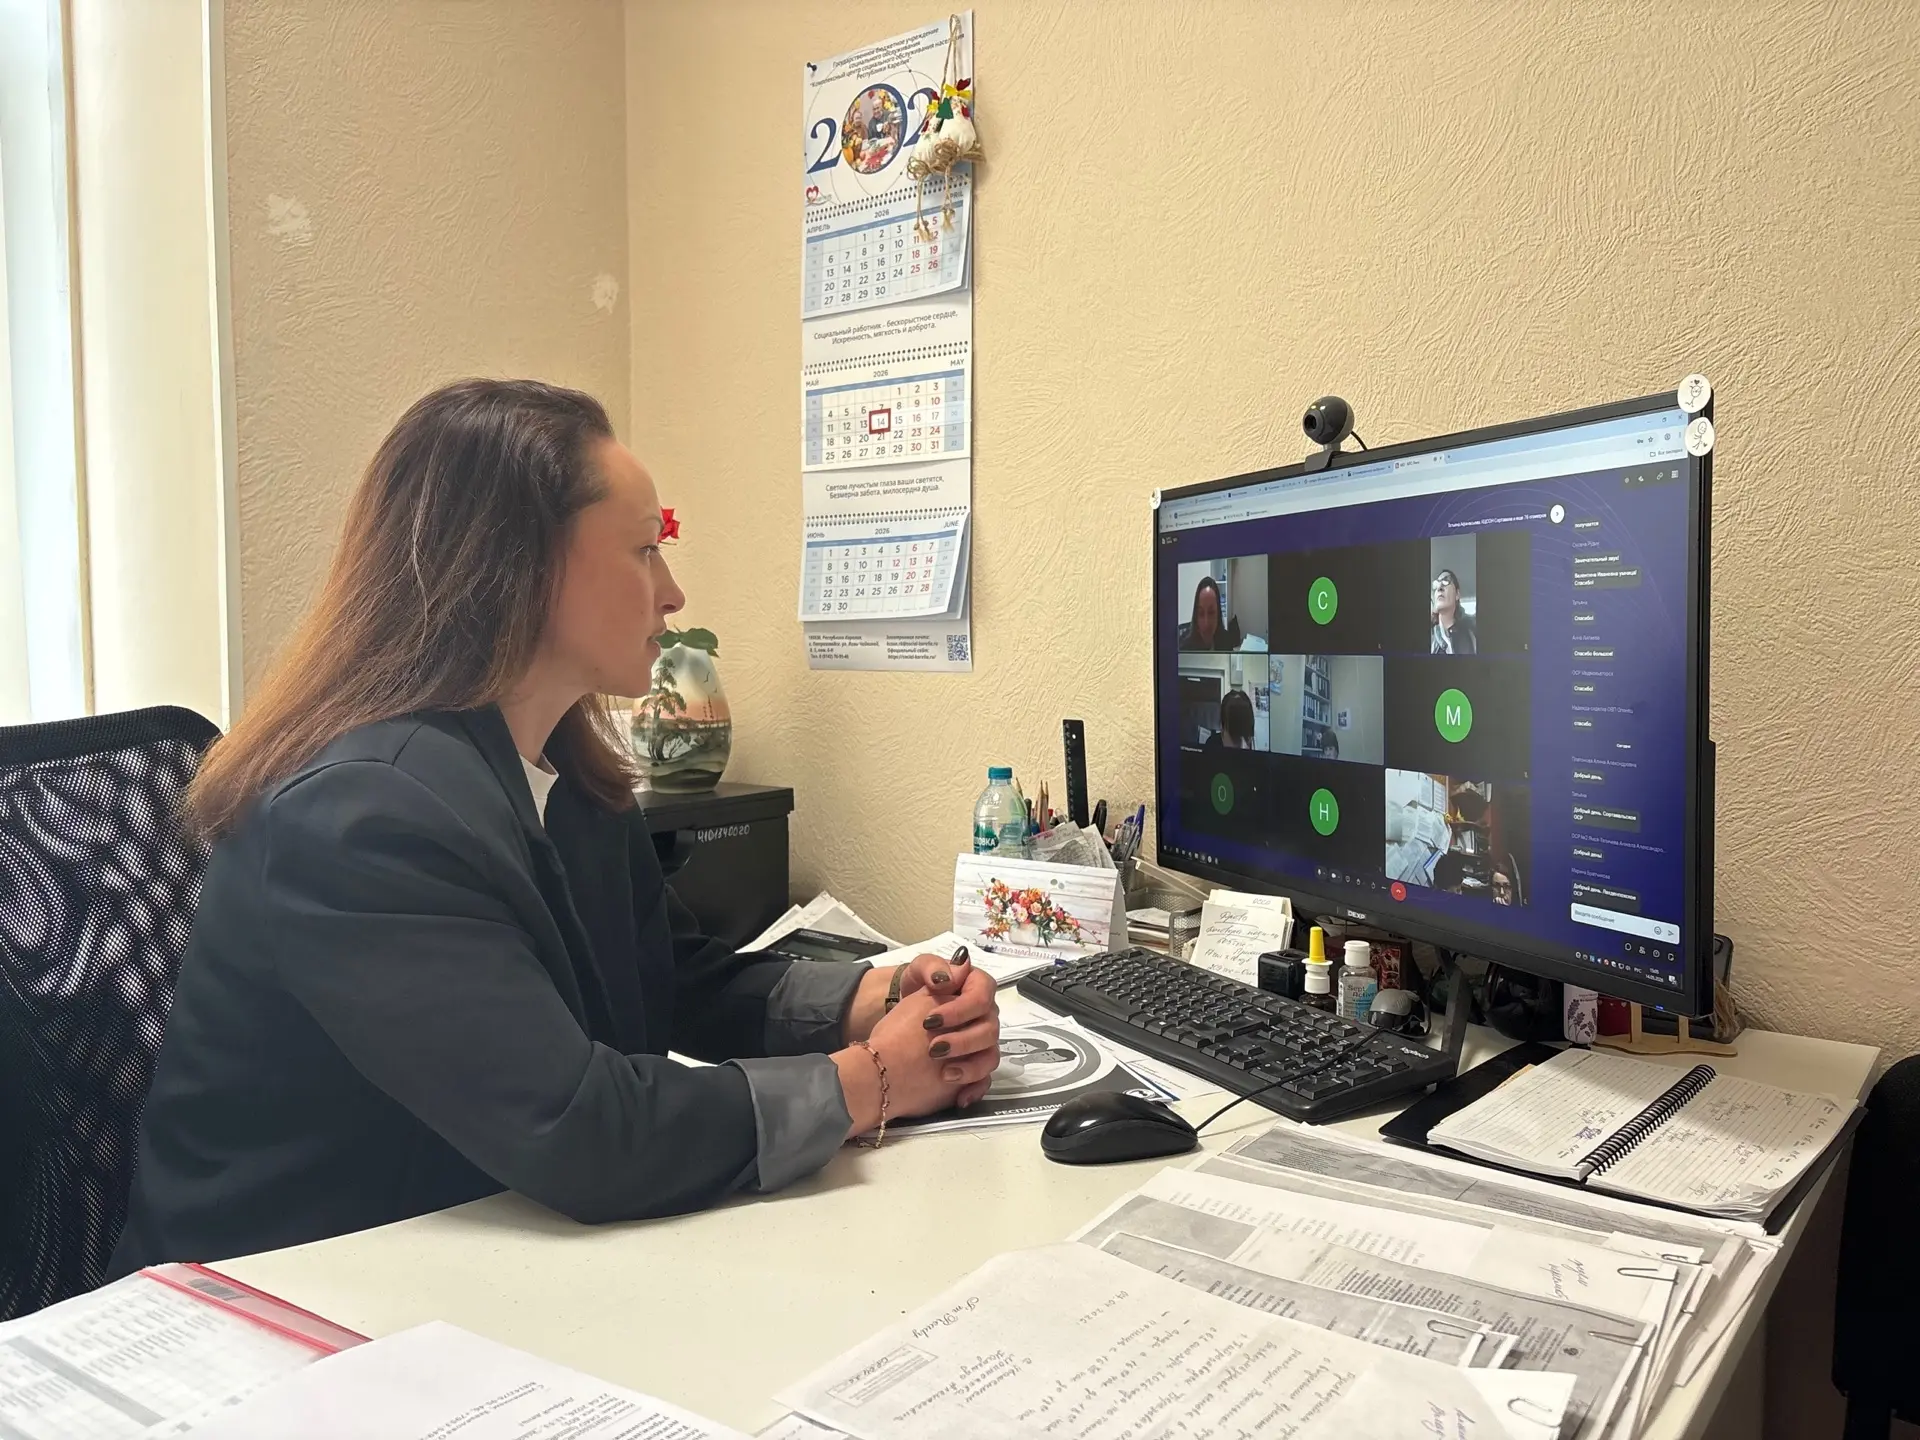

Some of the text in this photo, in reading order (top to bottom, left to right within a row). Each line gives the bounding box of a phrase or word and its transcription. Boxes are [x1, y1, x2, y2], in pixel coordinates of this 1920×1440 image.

[905, 27, 939, 46] учреждение
[846, 67, 862, 78] центр
[861, 57, 895, 72] социального
[895, 45, 934, 61] обслуживания
[848, 54, 881, 69] социального
[950, 191, 964, 199] PRIL
[874, 209, 890, 218] 2026
[806, 224, 831, 234] АПРЕЛЬ
[814, 309, 958, 340] Социальный работник бескорыстное сердце,
[832, 334, 872, 345] Искренность,
[873, 329, 901, 339] мягкость
[908, 322, 936, 334] доброта.
[950, 359, 965, 367] MAY
[873, 370, 889, 378] 2026
[931, 396, 941, 405] 10
[827, 411, 940, 432] 11 12 13 14 15 16 17
[826, 437, 834, 446] 18
[843, 435, 851, 444] 19
[859, 434, 869, 443] 20
[893, 430, 903, 439] 22
[911, 427, 922, 437] 23
[930, 426, 940, 435] 24
[825, 440, 939, 460] 25 26 27 28 29 30 31
[825, 475, 944, 492] Светом лучистым глаза ваши светятся,
[829, 484, 939, 500] Безмерна забота, милосердна душа.
[943, 519, 959, 528] JUNE
[807, 531, 825, 539] ИЮНЬ
[859, 561, 867, 569] 10
[877, 560, 883, 568] 11
[893, 559, 901, 567] 12
[909, 557, 917, 566] 13
[926, 556, 933, 564] 14
[825, 569, 931, 584] 15 16 17 18 19 20 21
[823, 583, 930, 598] 22 23 24 25 26 27 28
[822, 602, 848, 611] 29 30
[1574, 807, 1591, 815] Добрый
[1573, 848, 1591, 857] Добрый
[1573, 883, 1590, 891] Добрый
[1347, 909, 1366, 920] DEXP
[912, 1312, 959, 1339] Ready
